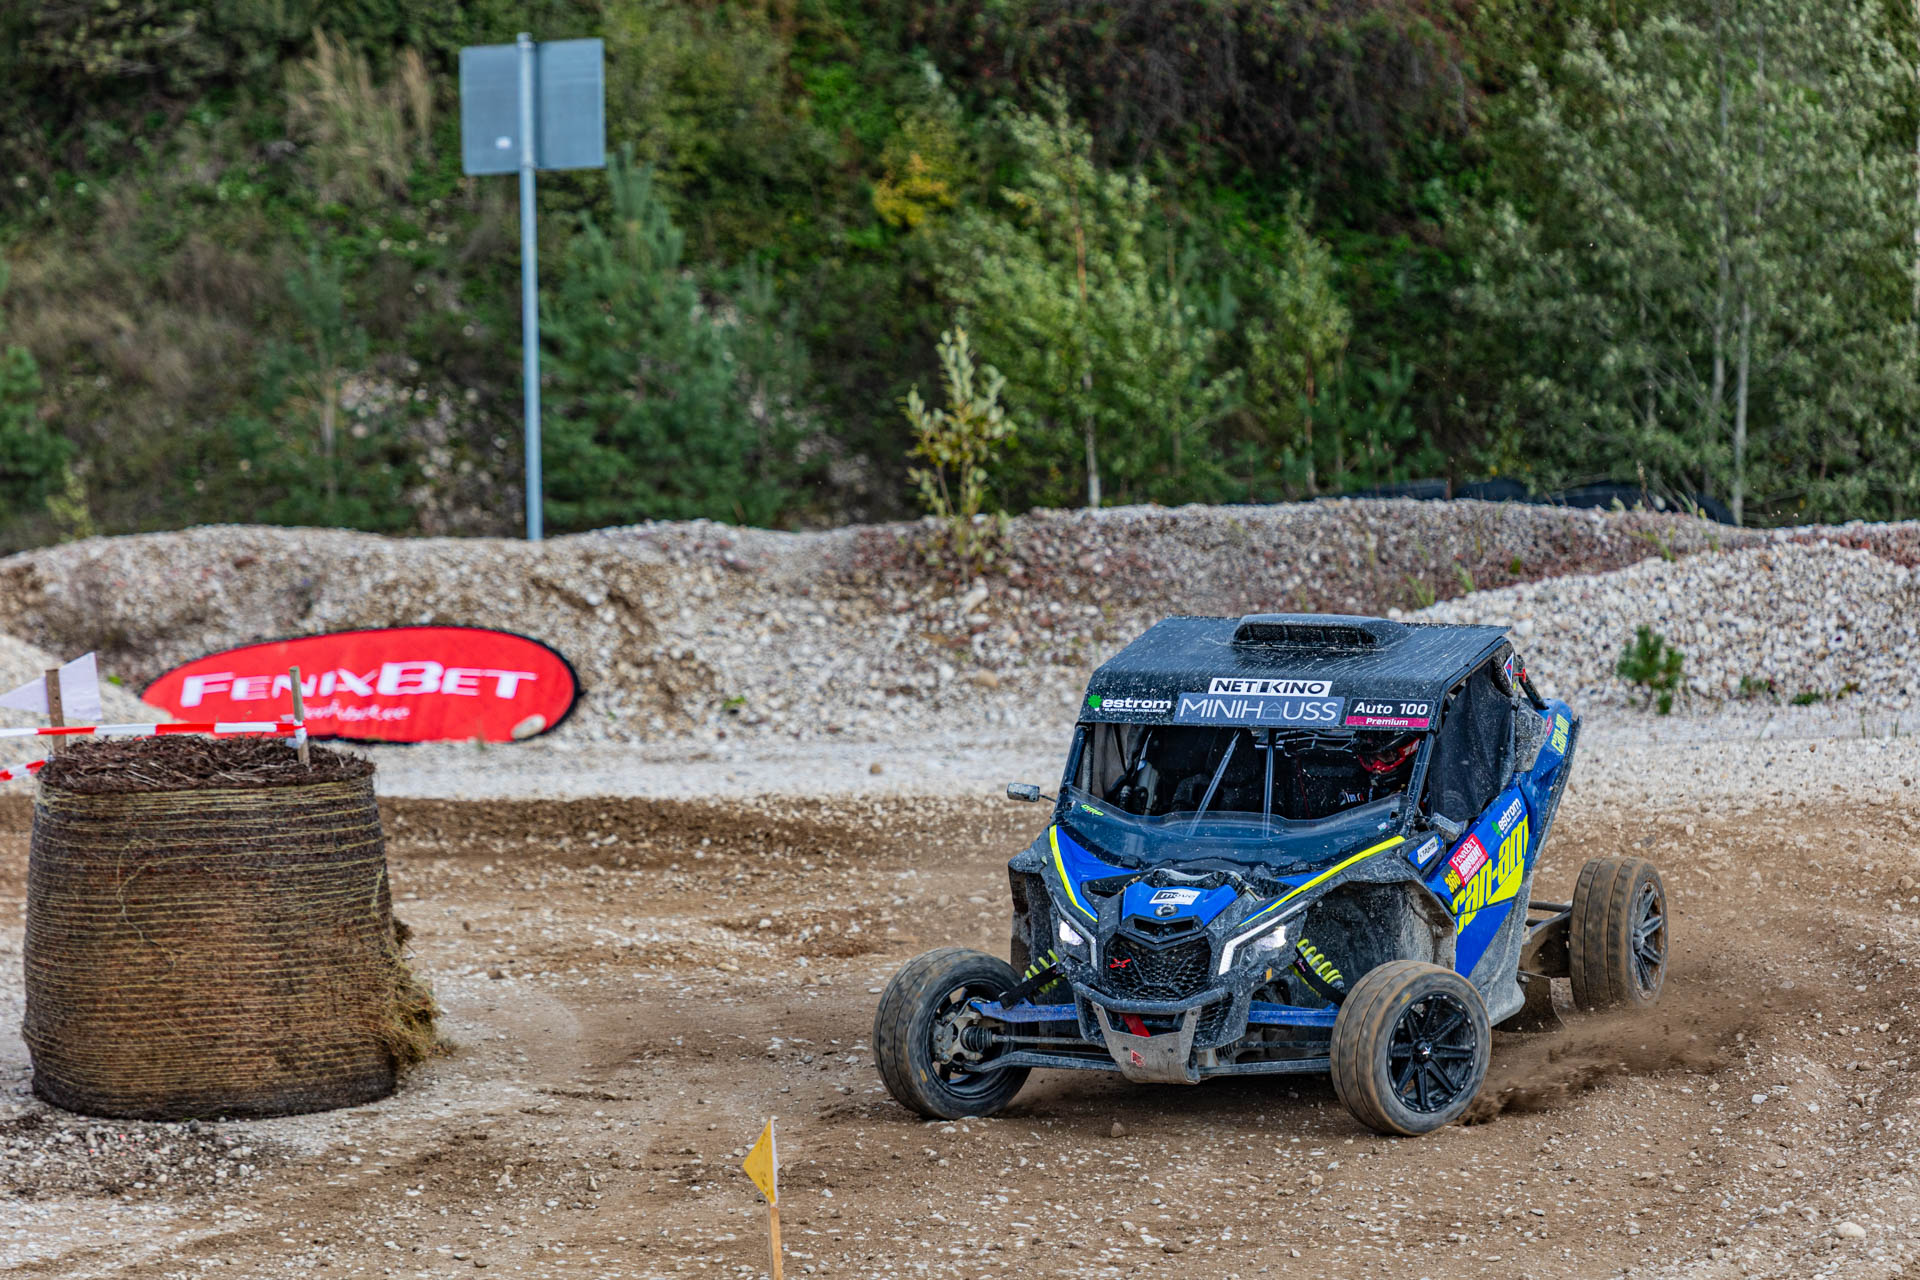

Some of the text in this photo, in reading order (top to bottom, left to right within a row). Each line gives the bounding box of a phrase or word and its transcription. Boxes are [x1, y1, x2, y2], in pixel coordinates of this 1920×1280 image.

[1102, 697, 1172, 710] estrom
[1353, 702, 1428, 716] Auto 100
[1365, 717, 1409, 727] Premium
[1497, 797, 1522, 831] estrom
[1444, 869, 1462, 894] 366
[1452, 815, 1529, 936] can-am
